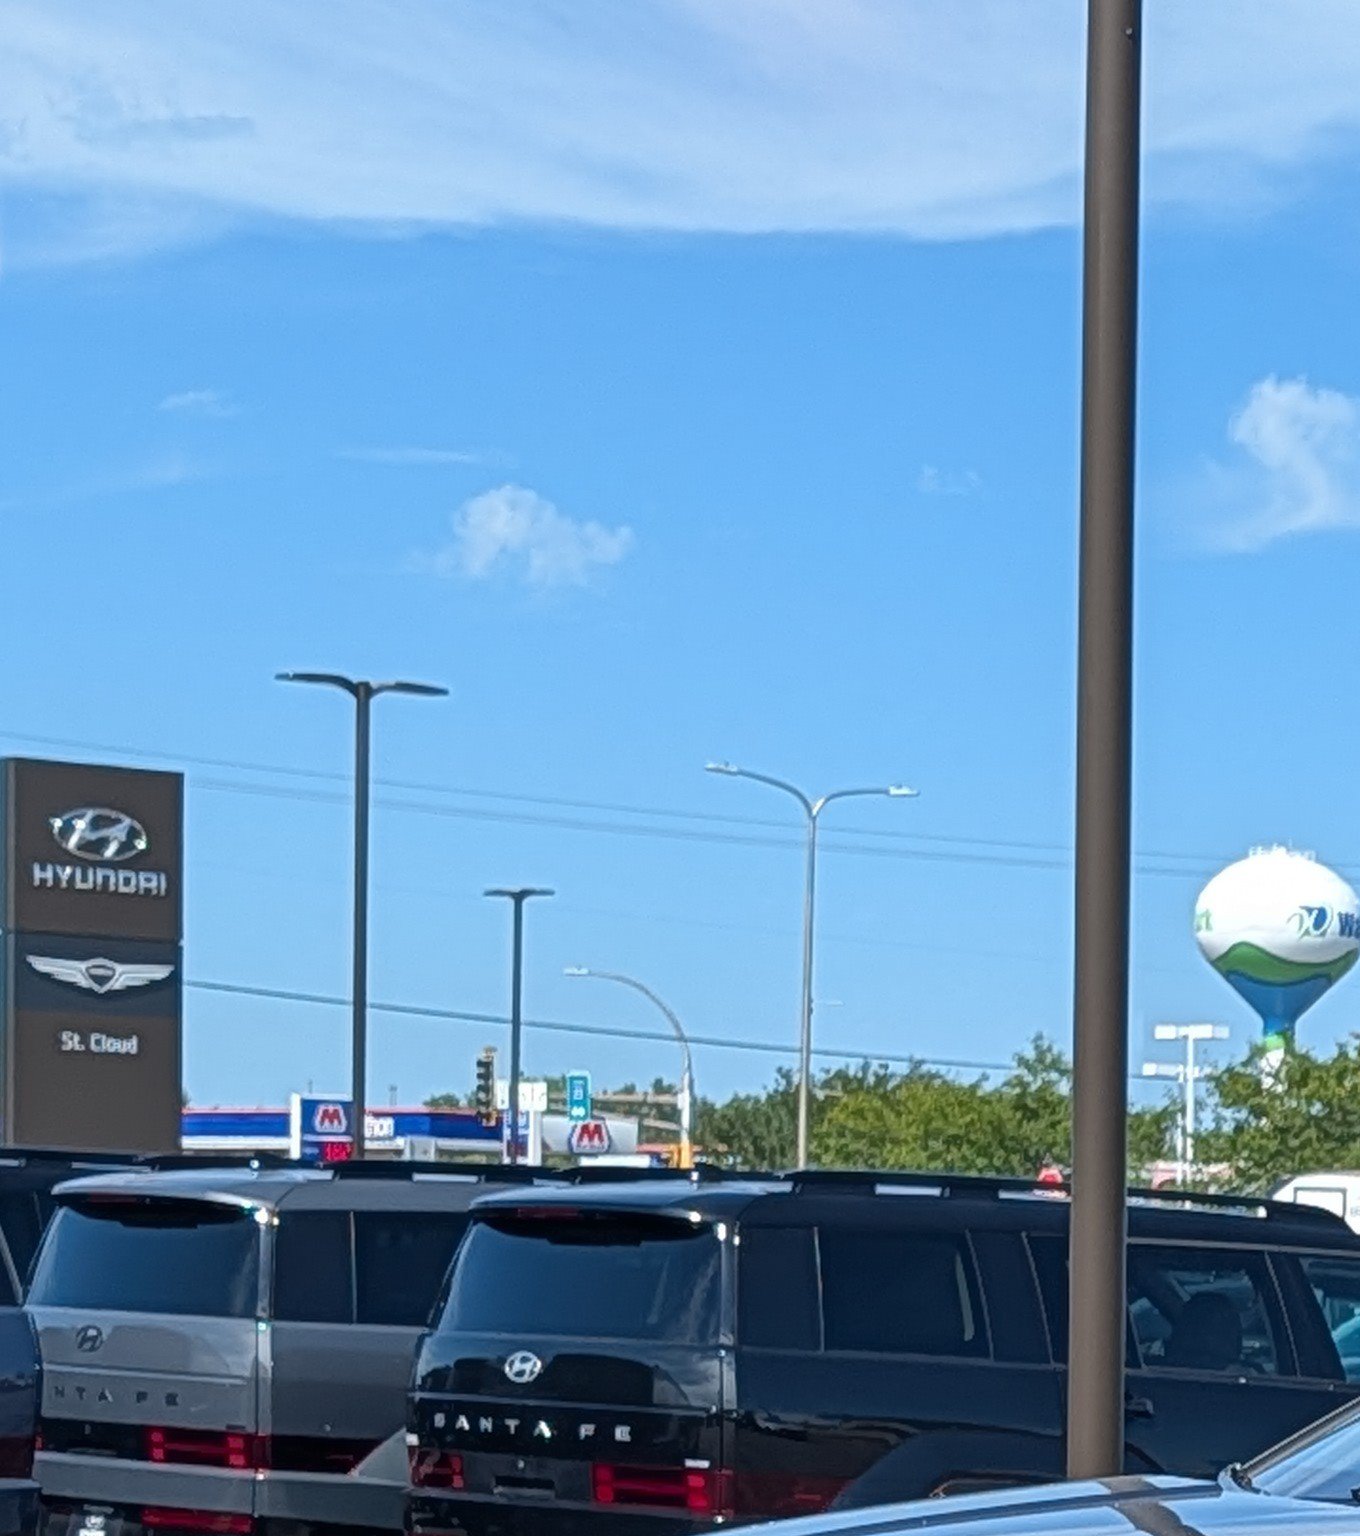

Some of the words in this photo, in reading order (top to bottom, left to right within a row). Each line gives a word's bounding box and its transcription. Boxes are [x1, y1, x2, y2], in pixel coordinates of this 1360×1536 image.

[33, 862, 167, 897] HYUNDAI
[60, 1030, 85, 1052] St.
[90, 1032, 138, 1055] Cloud
[54, 1385, 113, 1404] NTA
[433, 1412, 552, 1439] SANTA
[578, 1423, 632, 1442] FE
